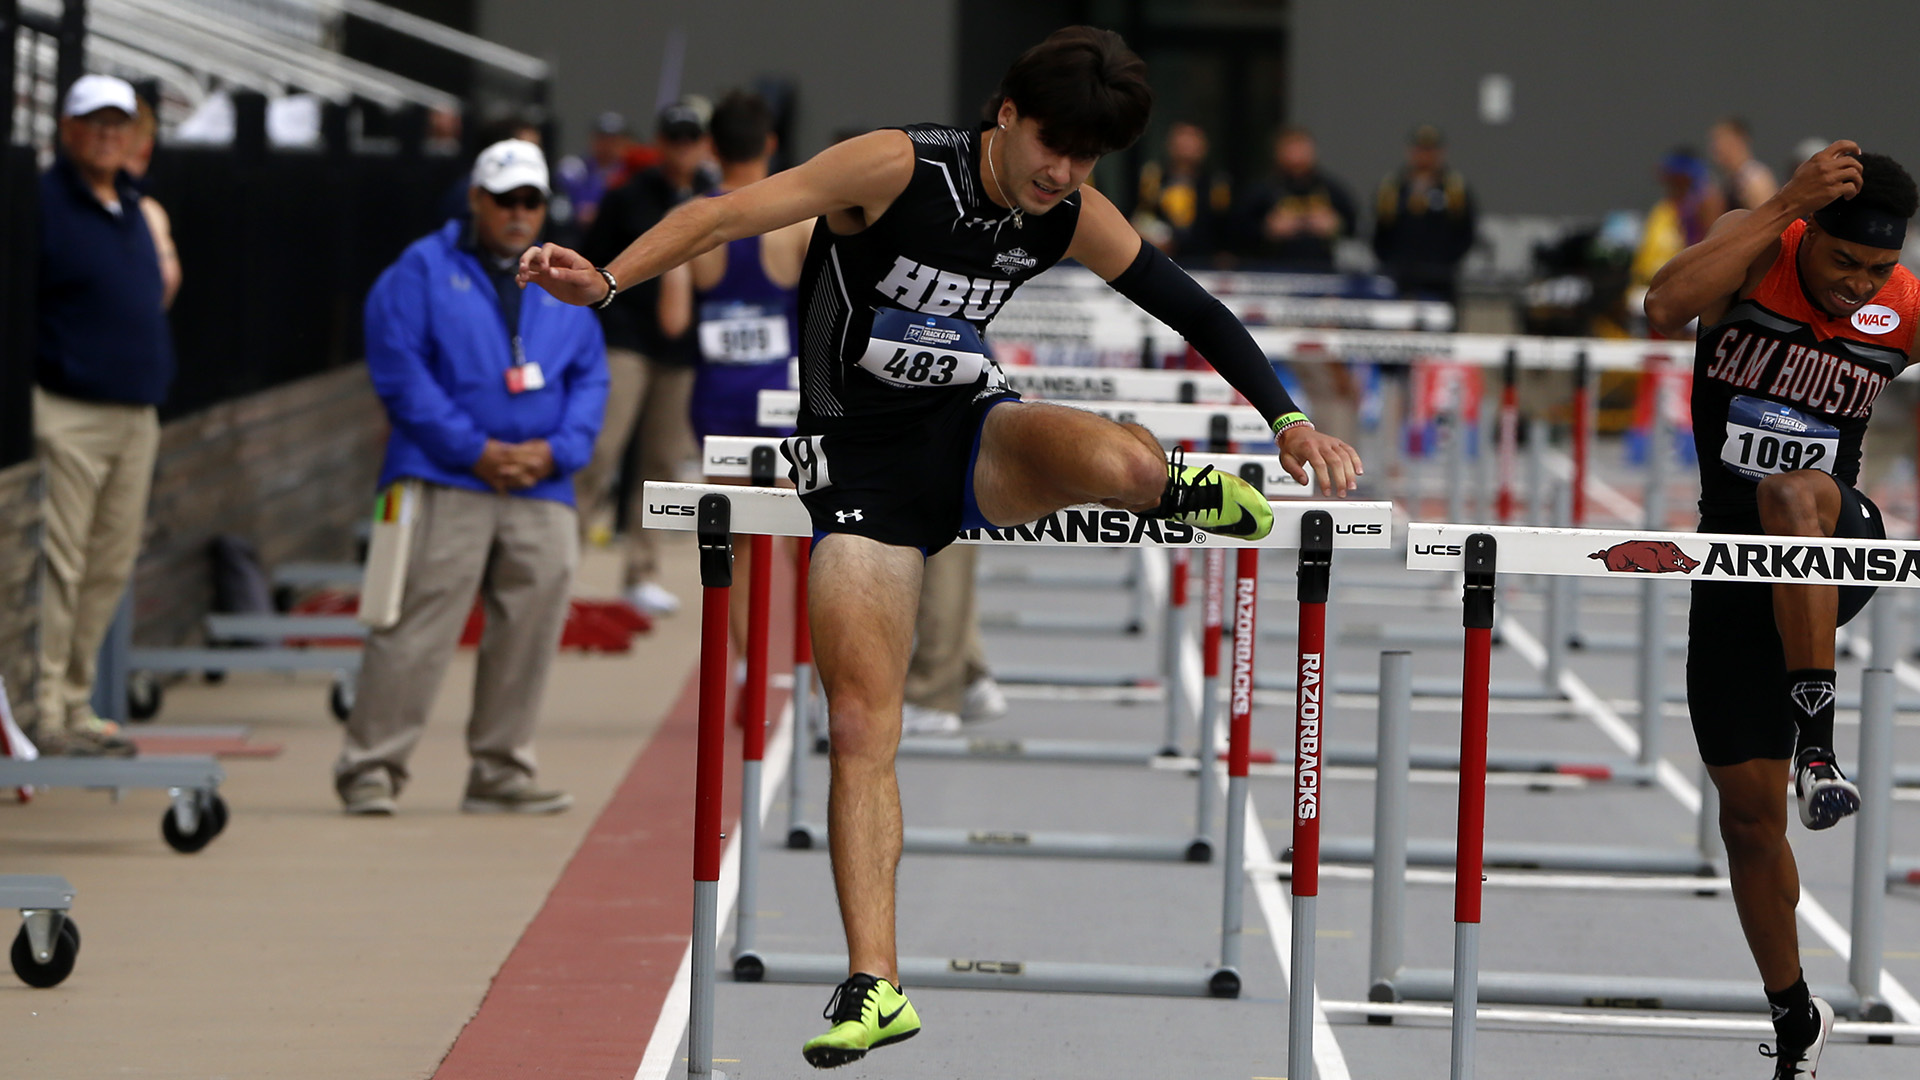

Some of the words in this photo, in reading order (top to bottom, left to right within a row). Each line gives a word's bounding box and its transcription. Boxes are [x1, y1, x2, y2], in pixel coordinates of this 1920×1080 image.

[994, 254, 1036, 268] SOUTHLAND
[875, 255, 1011, 319] HBU
[1857, 313, 1891, 327] WAC
[921, 329, 941, 338] TRACK
[883, 348, 958, 384] 483
[1707, 328, 1781, 389] SAM
[1768, 344, 1892, 418] HOUSTO
[1739, 432, 1826, 473] 1092
[711, 456, 748, 465] UCS
[1268, 475, 1298, 484] UC
[650, 504, 696, 516] UCS
[1336, 523, 1383, 534] UCS
[1414, 544, 1463, 555] UCS
[1232, 578, 1254, 715] RAZORBACKS
[1298, 652, 1321, 819] RAZORBACKS
[951, 958, 1021, 975] UCS
